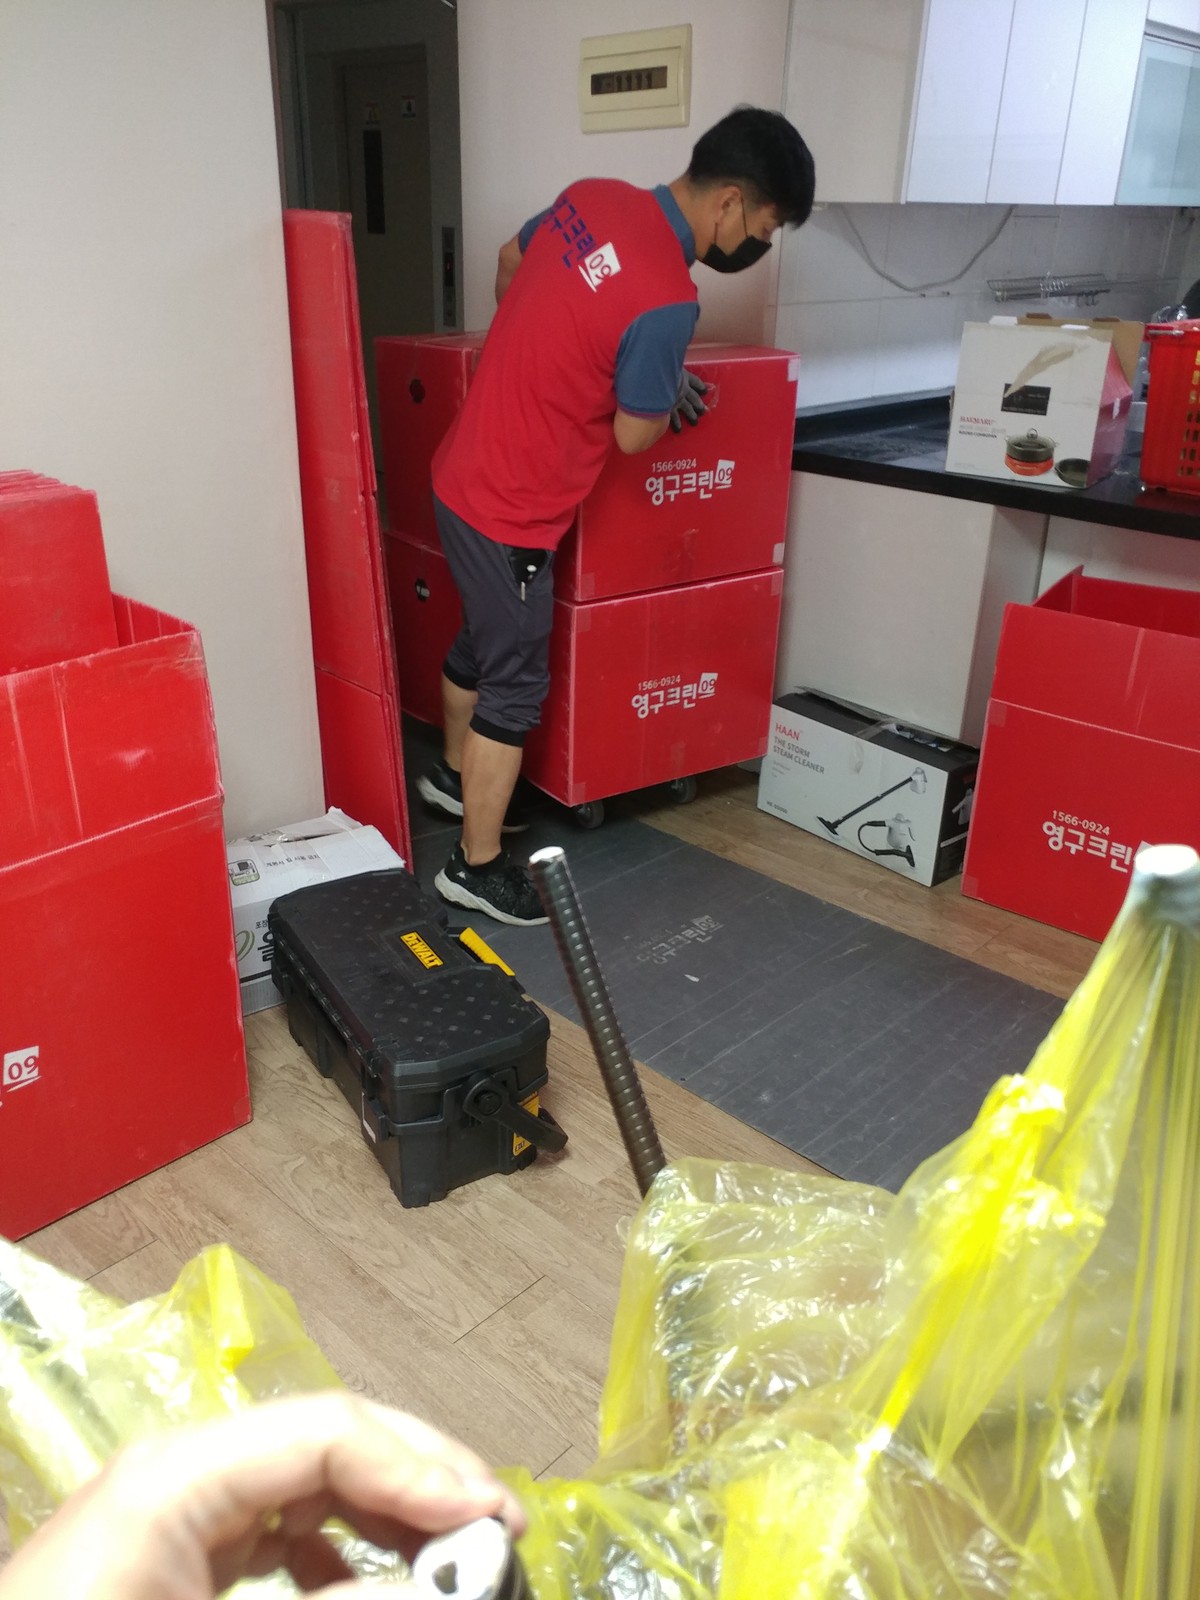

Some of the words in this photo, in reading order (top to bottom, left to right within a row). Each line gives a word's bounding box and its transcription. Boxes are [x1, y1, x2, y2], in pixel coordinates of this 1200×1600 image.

[651, 458, 697, 473] 1566-0924
[645, 470, 714, 506] 영구크린
[638, 674, 681, 691] 1566-0924
[631, 683, 697, 719] 영구크린
[775, 722, 800, 741] HAAN
[773, 745, 794, 760] STEAM
[794, 755, 825, 774] CLEANER
[774, 736, 786, 747] THE
[787, 742, 810, 758] STORM
[1052, 809, 1110, 836] 1566-0924
[1042, 821, 1133, 873] 영구크린
[402, 932, 441, 968] DEWALT
